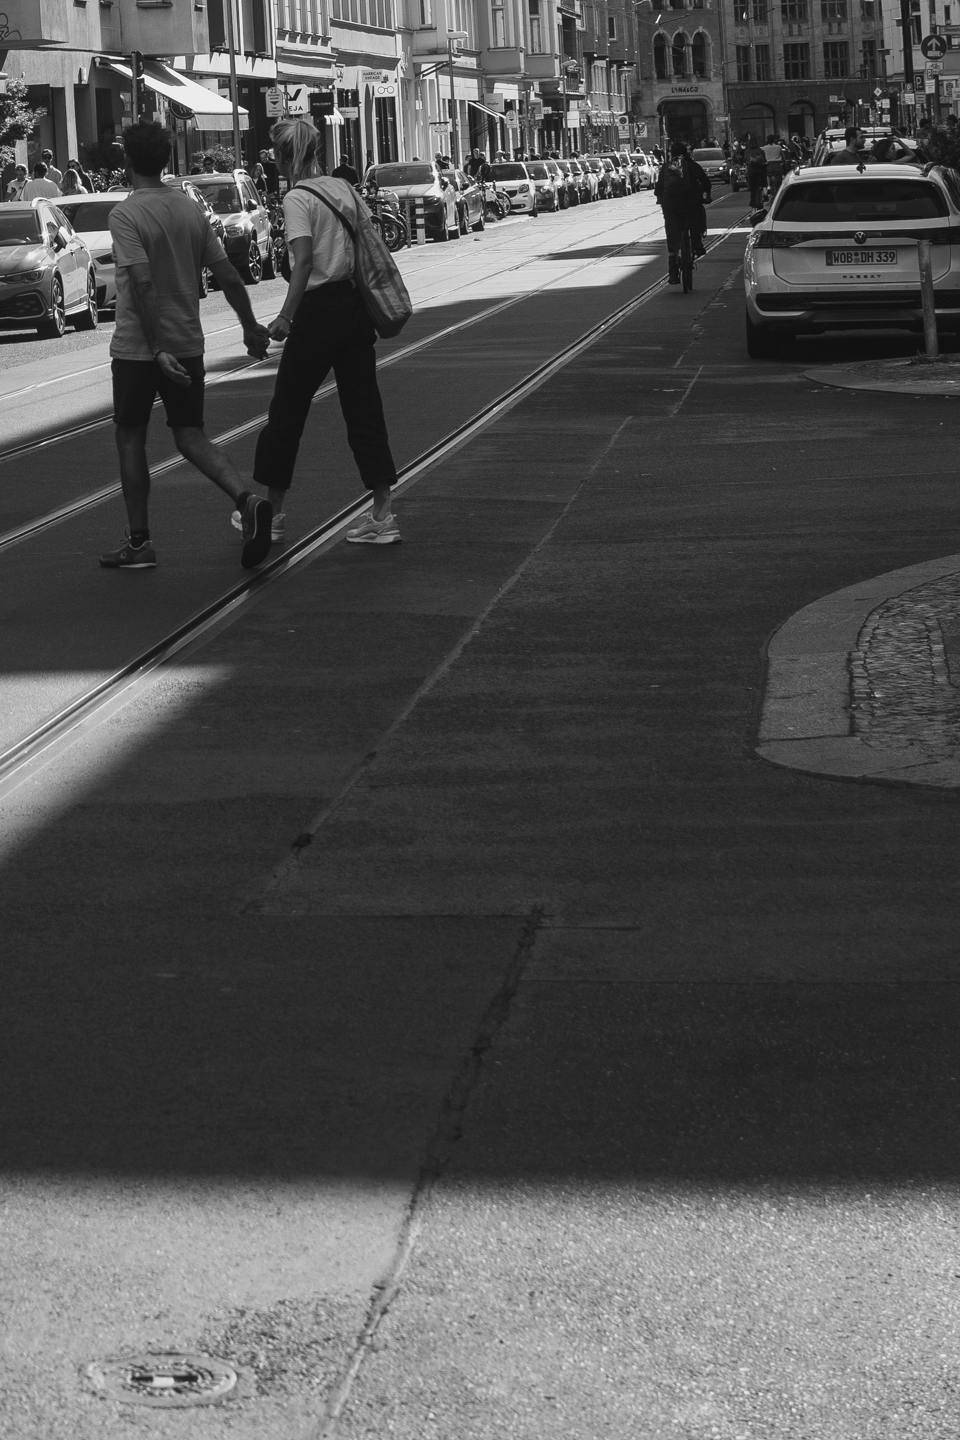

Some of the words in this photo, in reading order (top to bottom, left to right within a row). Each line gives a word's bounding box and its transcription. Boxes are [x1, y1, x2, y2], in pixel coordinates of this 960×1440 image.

[833, 253, 853, 264] WOB
[860, 252, 874, 263] DH
[876, 251, 896, 263] 339
